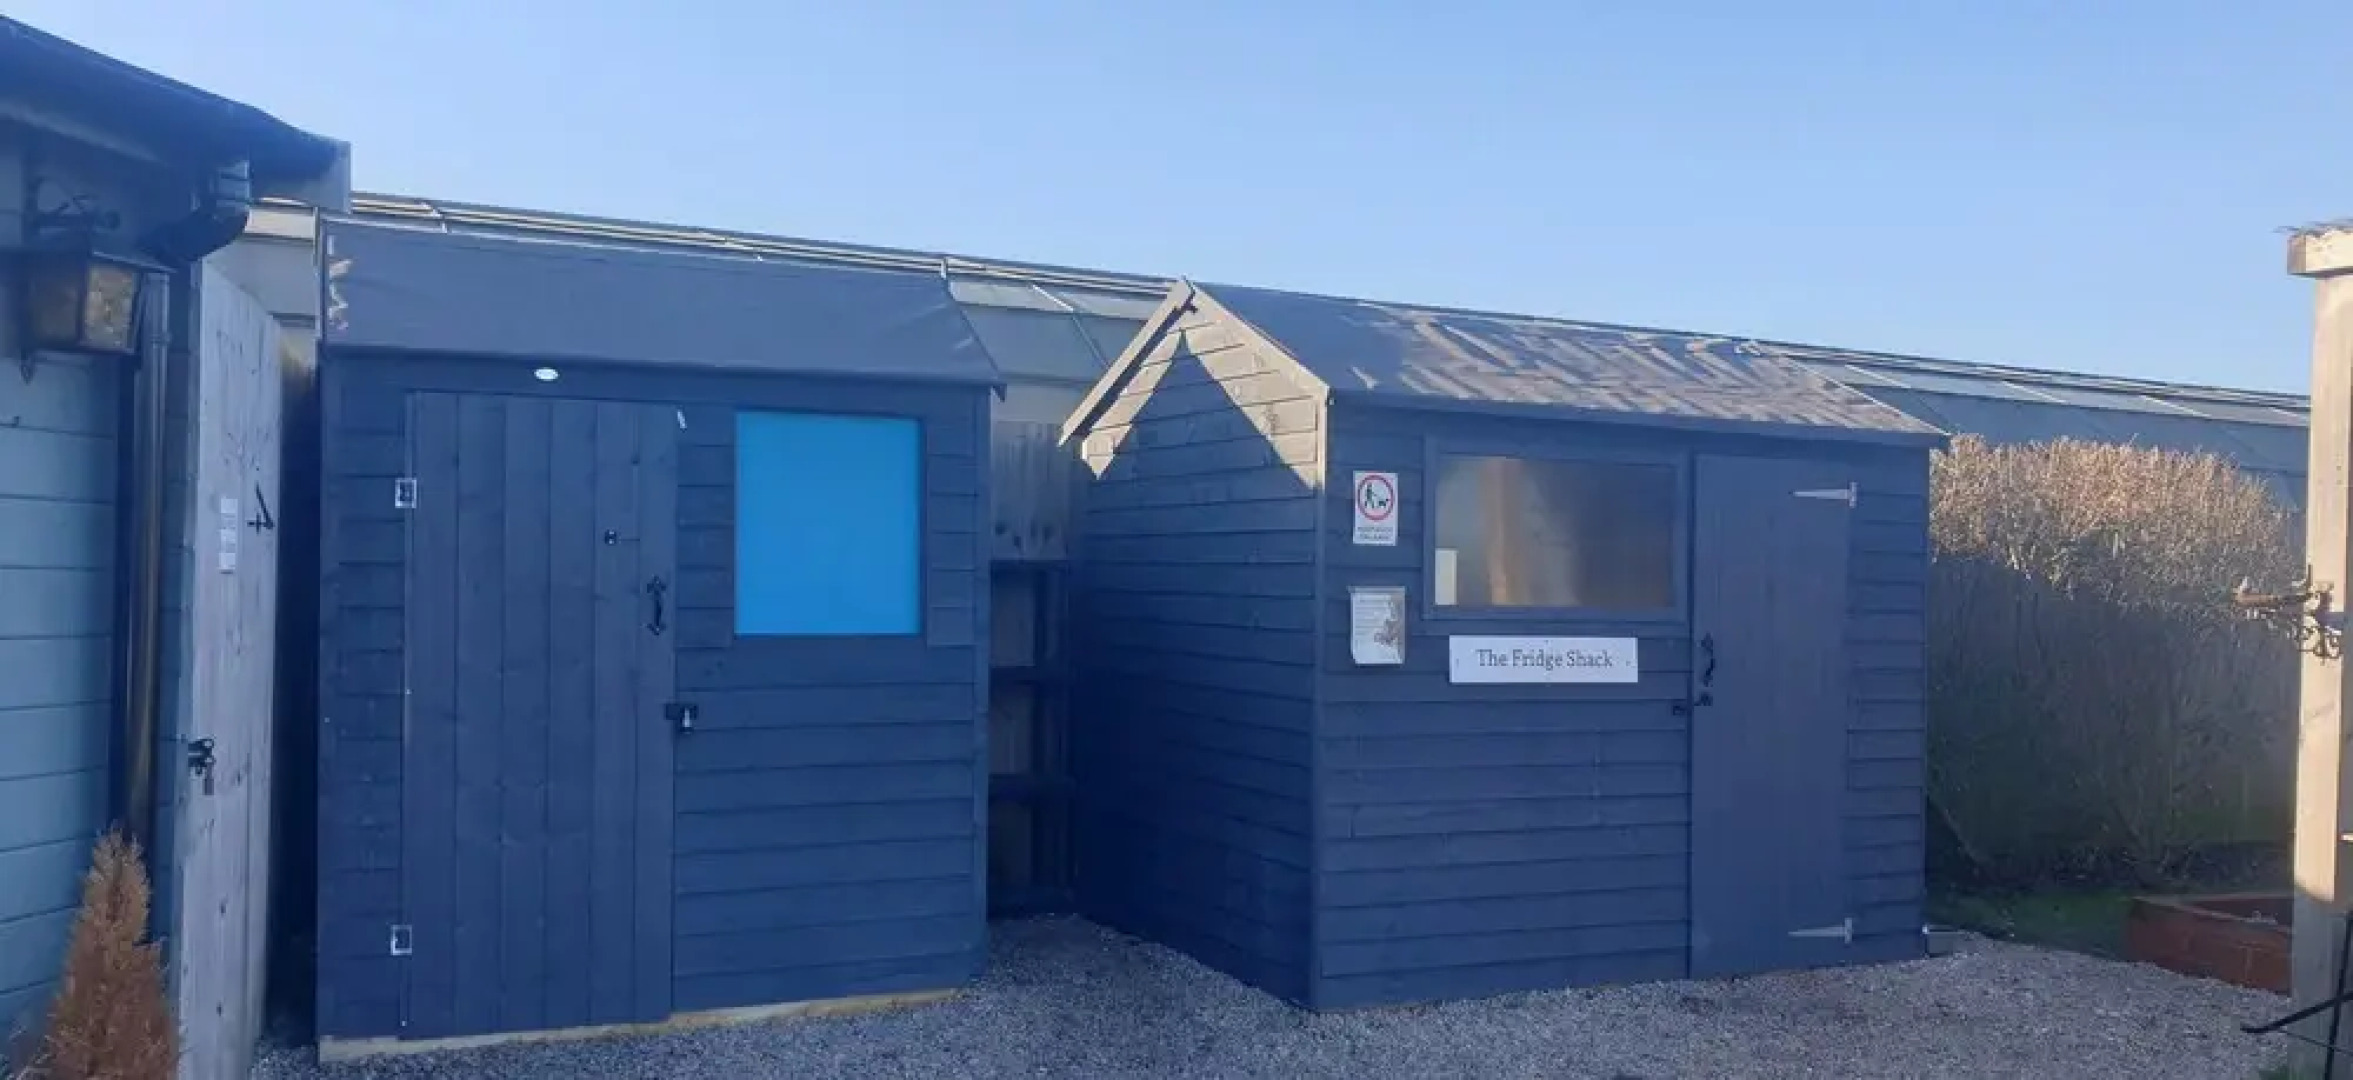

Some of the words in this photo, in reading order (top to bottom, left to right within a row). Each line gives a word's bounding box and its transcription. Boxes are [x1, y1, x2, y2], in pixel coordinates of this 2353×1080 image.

[1476, 649, 1508, 666] The
[1512, 648, 1563, 671] Fridge
[1566, 649, 1612, 667] Shack
